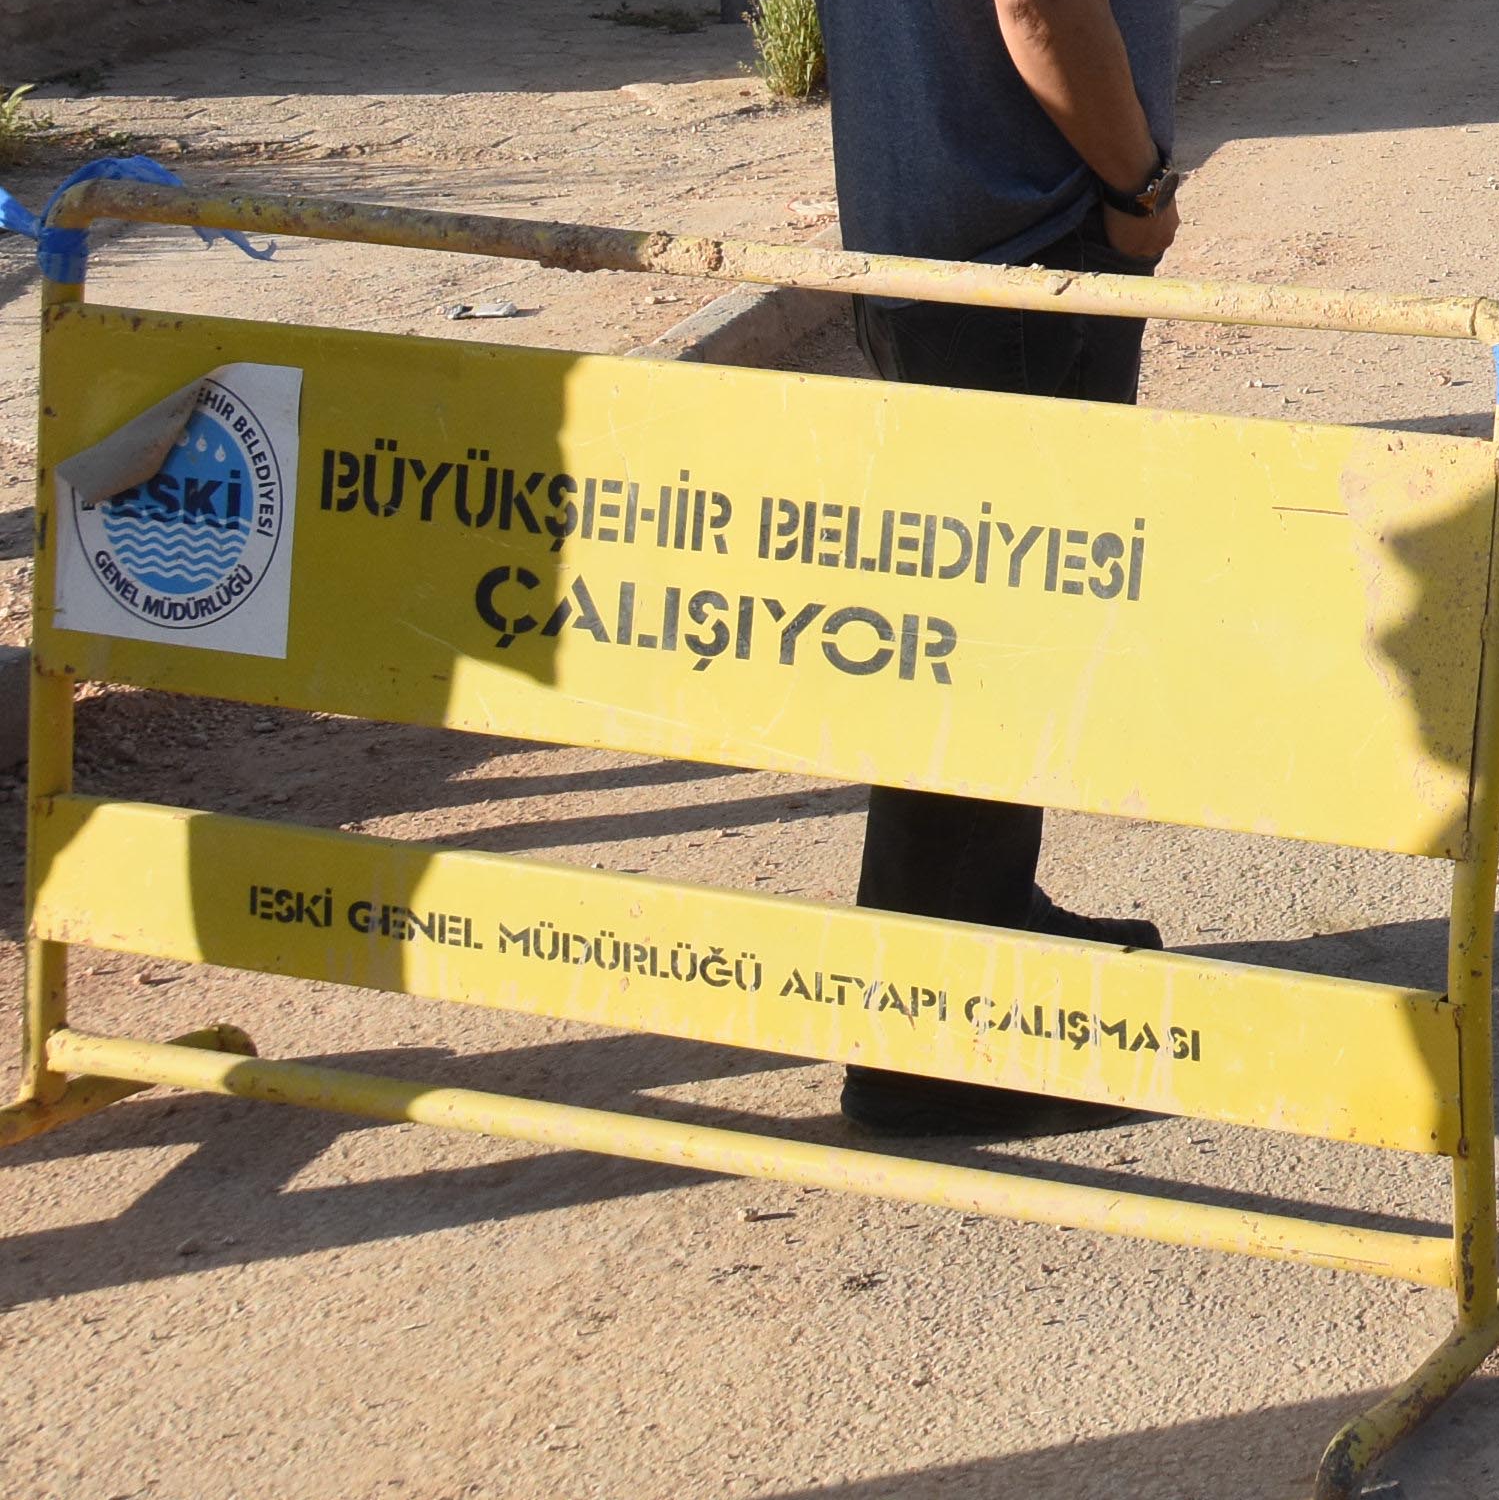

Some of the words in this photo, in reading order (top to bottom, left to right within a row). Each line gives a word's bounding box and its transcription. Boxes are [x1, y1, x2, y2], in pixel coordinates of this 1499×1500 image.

[94, 550, 140, 608] GENEL
[142, 563, 254, 622] MÜDÜRLÜĞÜ
[320, 438, 733, 555] BÜYÜKŞEHİR
[757, 496, 1146, 602] BELEDİYESİ
[474, 565, 958, 686] ÇALIŞIYOR
[249, 884, 333, 928] ESKİ
[347, 900, 484, 950] GENEL
[498, 920, 763, 993] MÜDÜRLÜĞÜ
[778, 967, 948, 1023] ALTYAPI
[963, 995, 1201, 1063] ÇALIŞMASI
